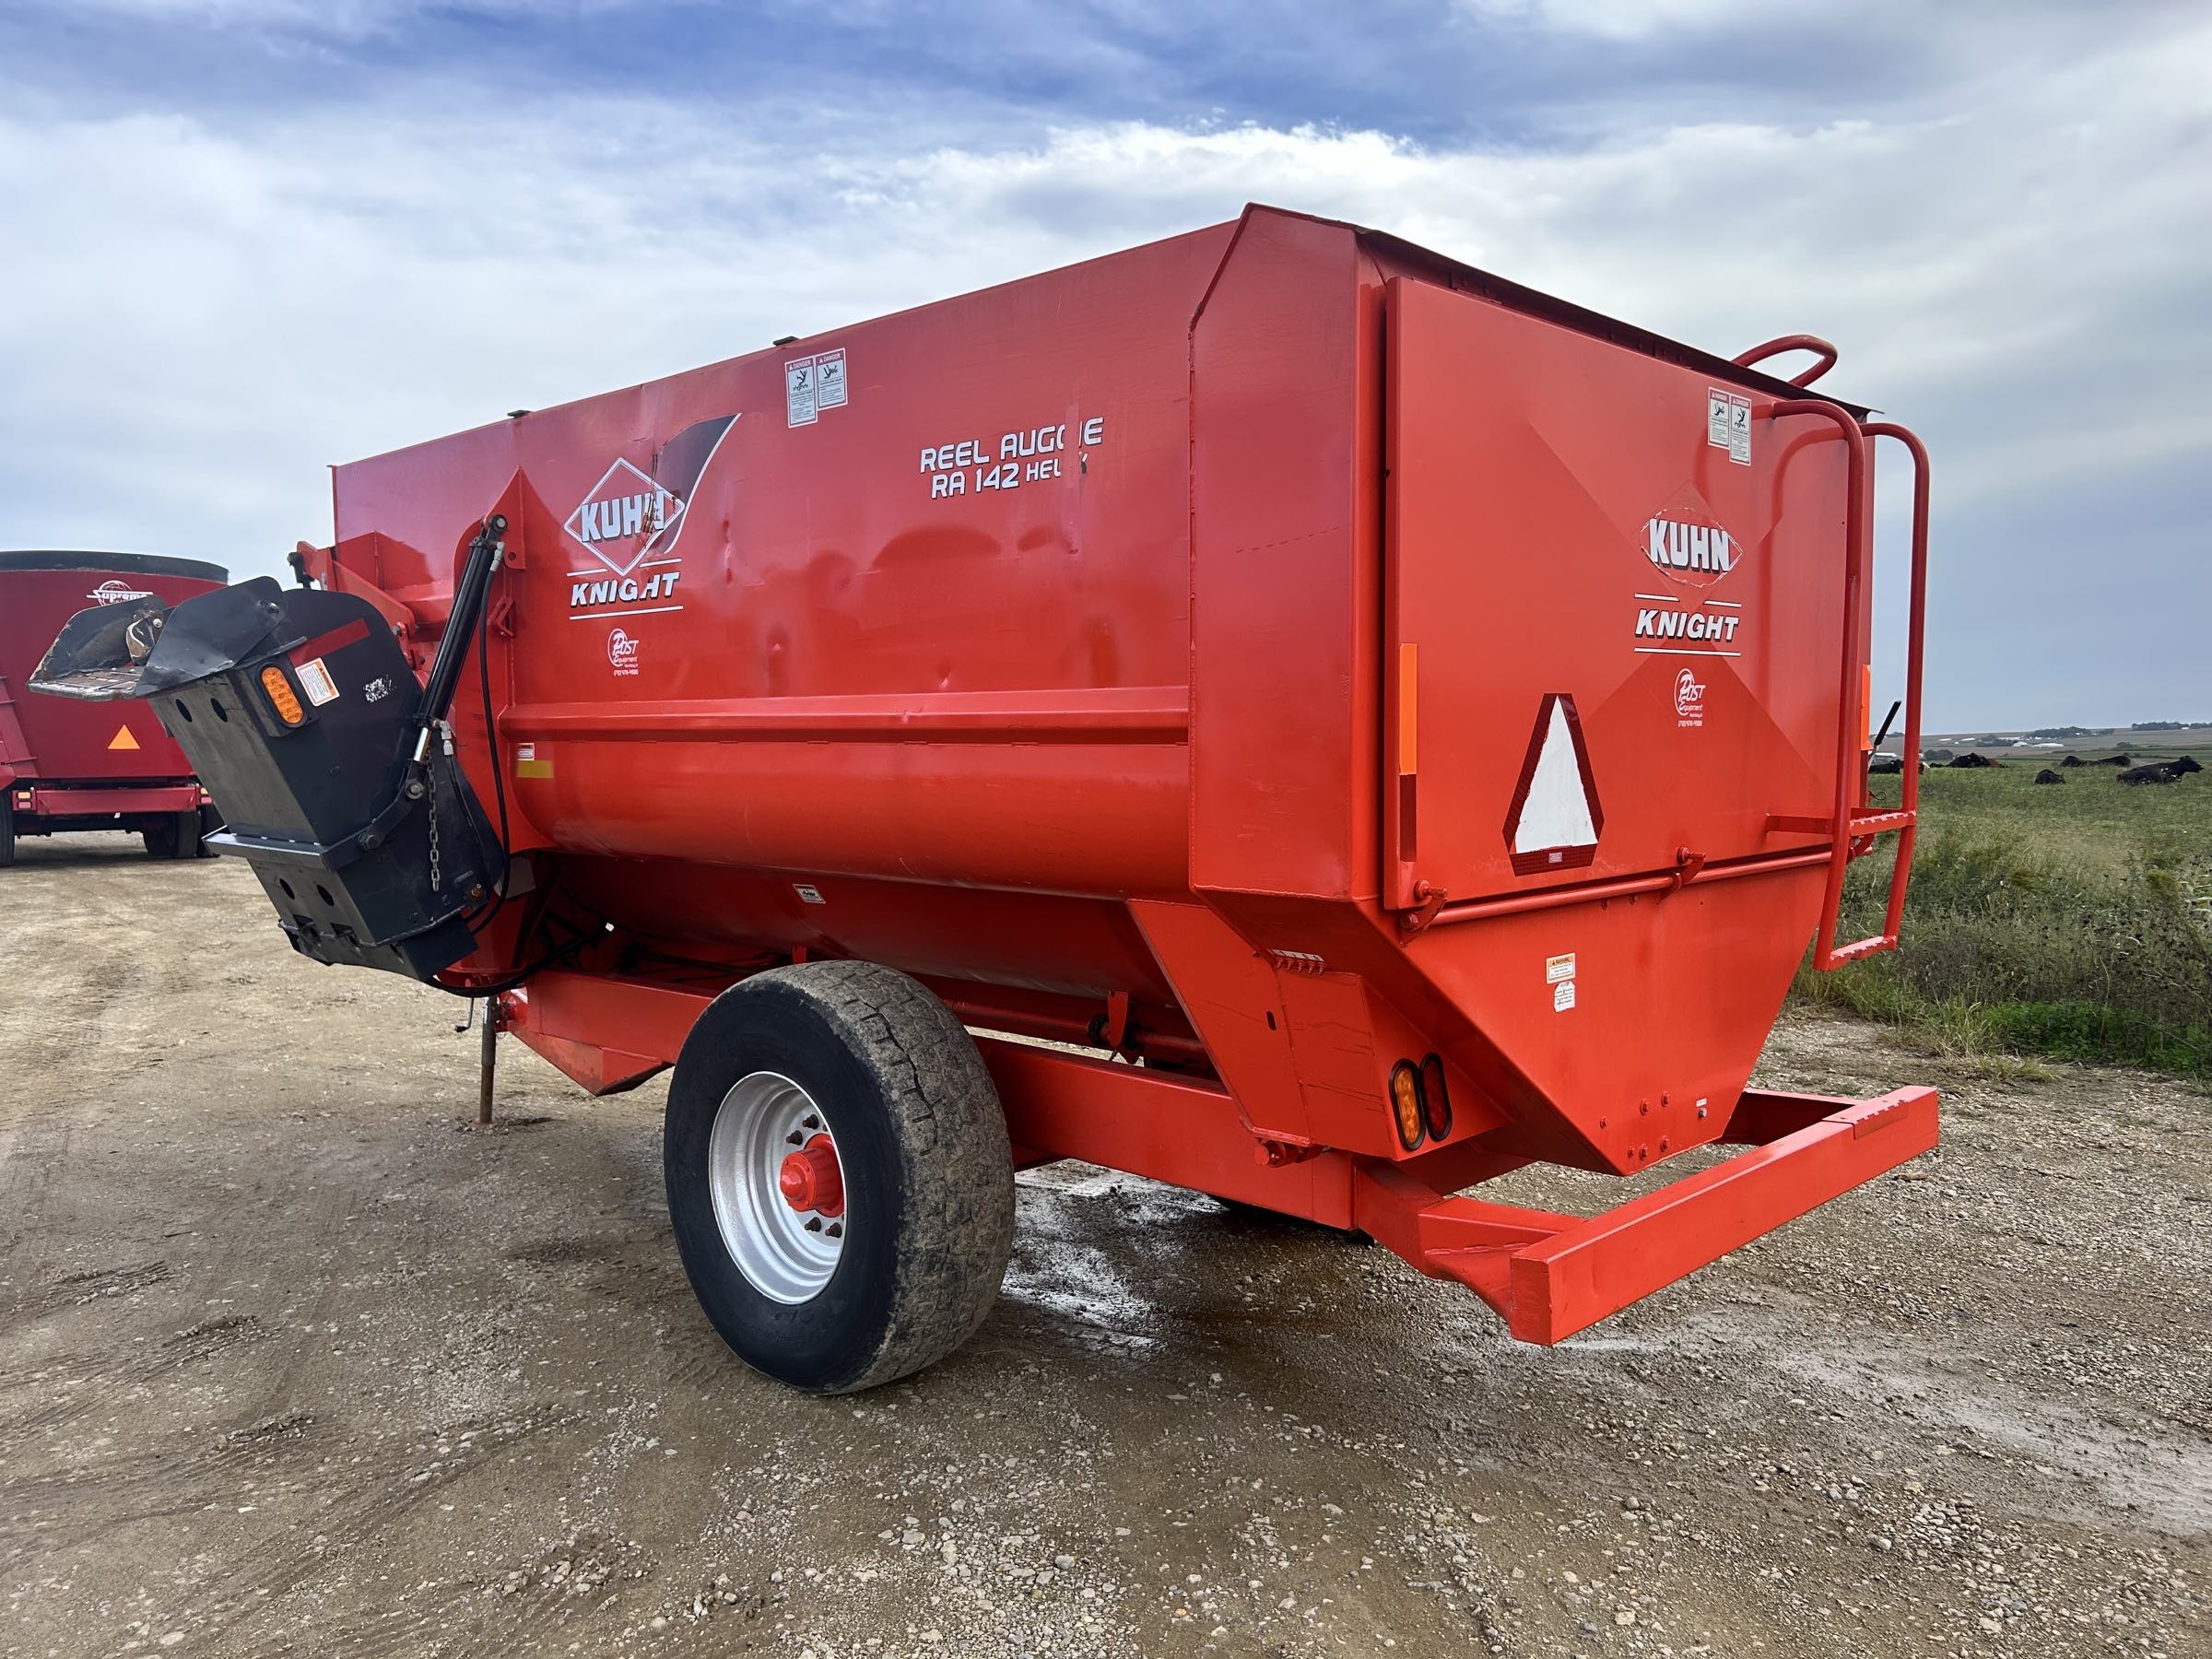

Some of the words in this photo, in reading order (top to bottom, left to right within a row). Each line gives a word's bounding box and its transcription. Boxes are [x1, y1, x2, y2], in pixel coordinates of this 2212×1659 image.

[920, 440, 990, 473] REEL
[1000, 418, 1103, 460] AUGE
[931, 471, 965, 499] RA
[975, 463, 1019, 492] 142
[581, 489, 665, 543] KUHN
[1649, 518, 1731, 571] KUHN
[571, 571, 680, 607] KNIGHT
[1635, 609, 1739, 641] KNIGHT
